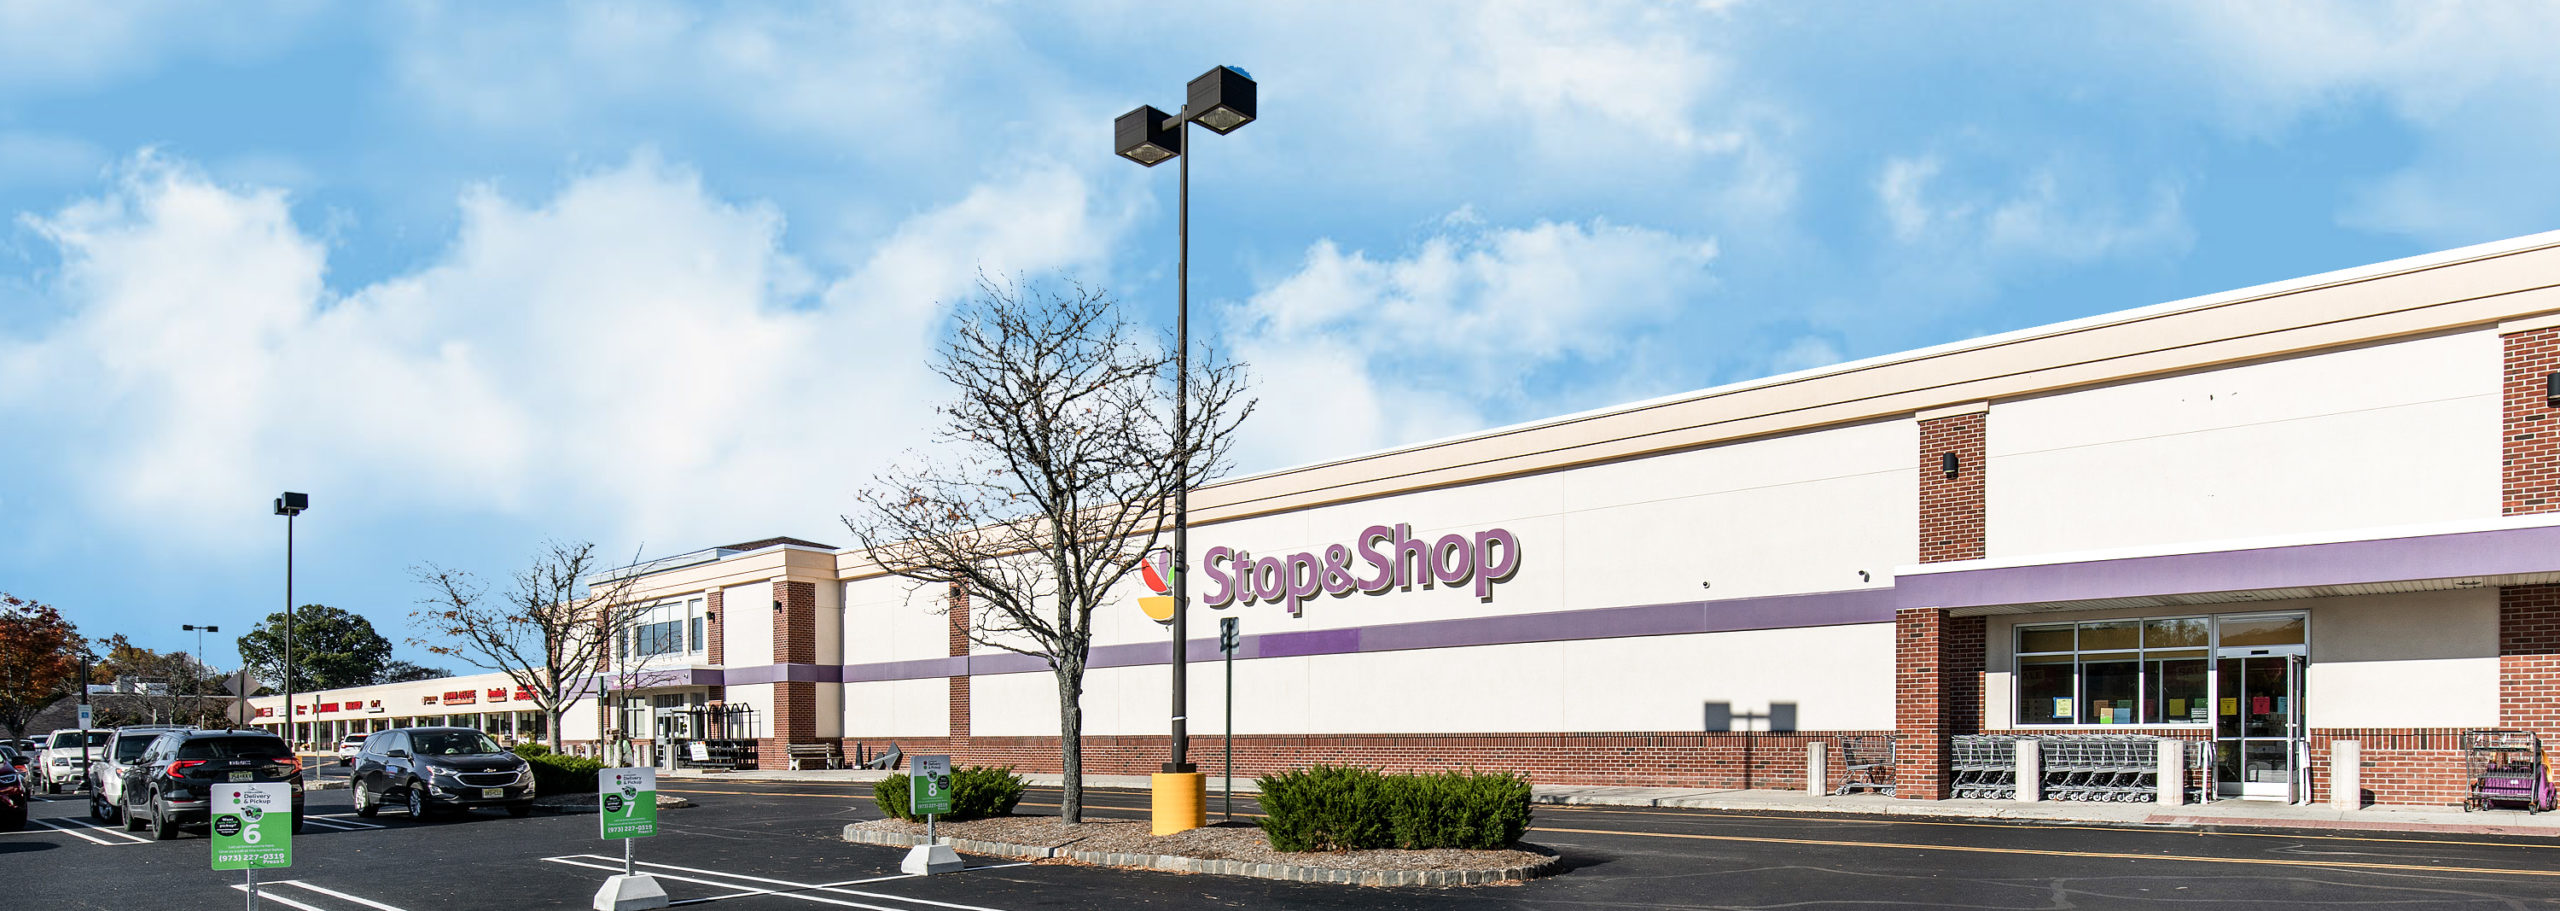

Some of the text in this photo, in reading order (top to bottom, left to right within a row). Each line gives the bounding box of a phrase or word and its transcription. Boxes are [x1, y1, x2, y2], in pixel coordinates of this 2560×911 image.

[1203, 522, 1520, 615] Stop&Shop
[928, 783, 937, 797] 8
[624, 801, 635, 817] 7
[243, 823, 261, 844] 6
[219, 854, 241, 862] (973)
